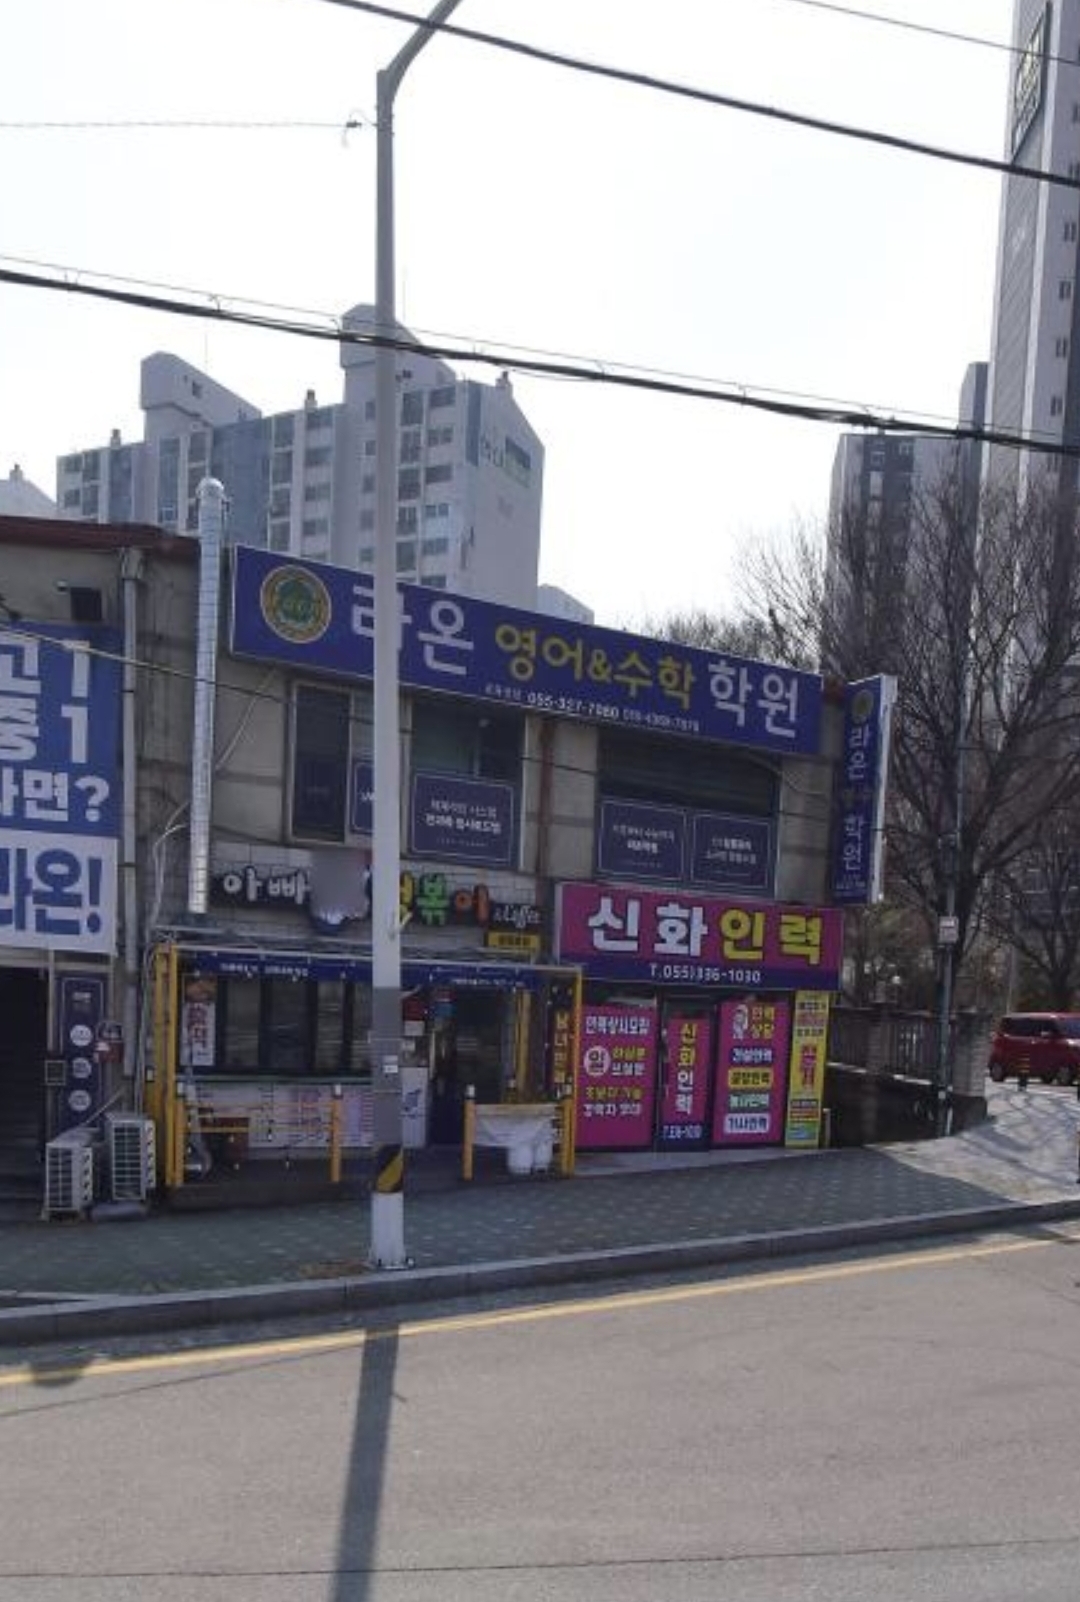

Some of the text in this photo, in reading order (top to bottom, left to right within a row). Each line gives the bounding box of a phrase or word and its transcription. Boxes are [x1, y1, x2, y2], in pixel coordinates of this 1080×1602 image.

[495, 624, 697, 710] 영어&수학
[707, 659, 800, 738] 학원
[60, 704, 88, 764] 1
[223, 866, 309, 904] 아빠
